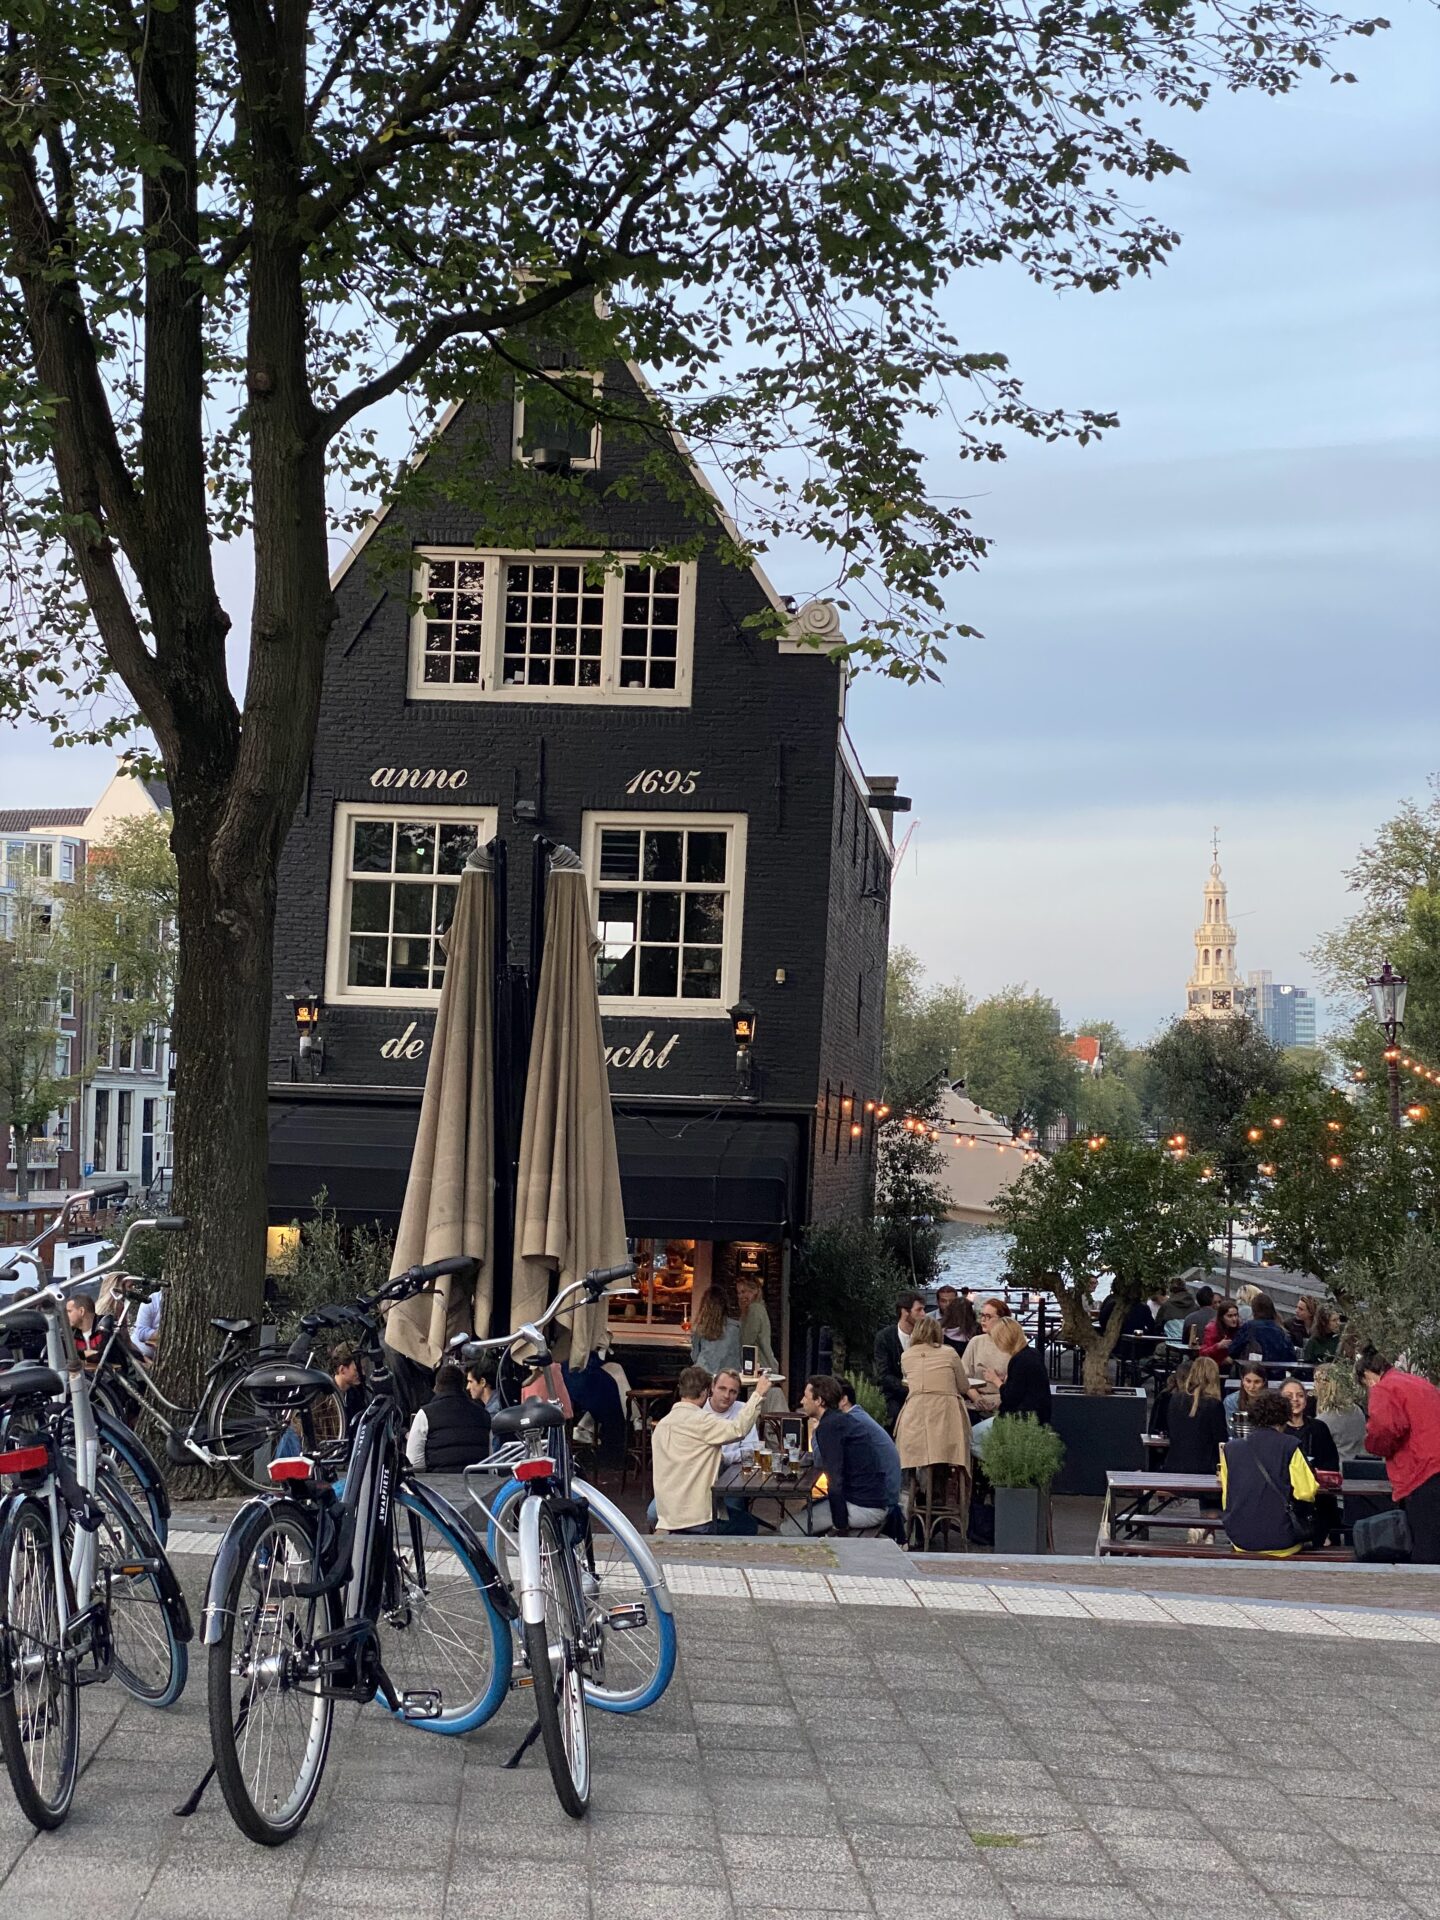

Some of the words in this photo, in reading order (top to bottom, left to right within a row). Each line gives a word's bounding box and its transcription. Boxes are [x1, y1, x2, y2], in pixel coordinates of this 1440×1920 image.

[369, 766, 468, 789] anno
[626, 769, 701, 794] 1695
[1280, 986, 1292, 994] UP
[379, 1022, 424, 1060] de
[379, 1468, 390, 1521] SWAPFIETS
